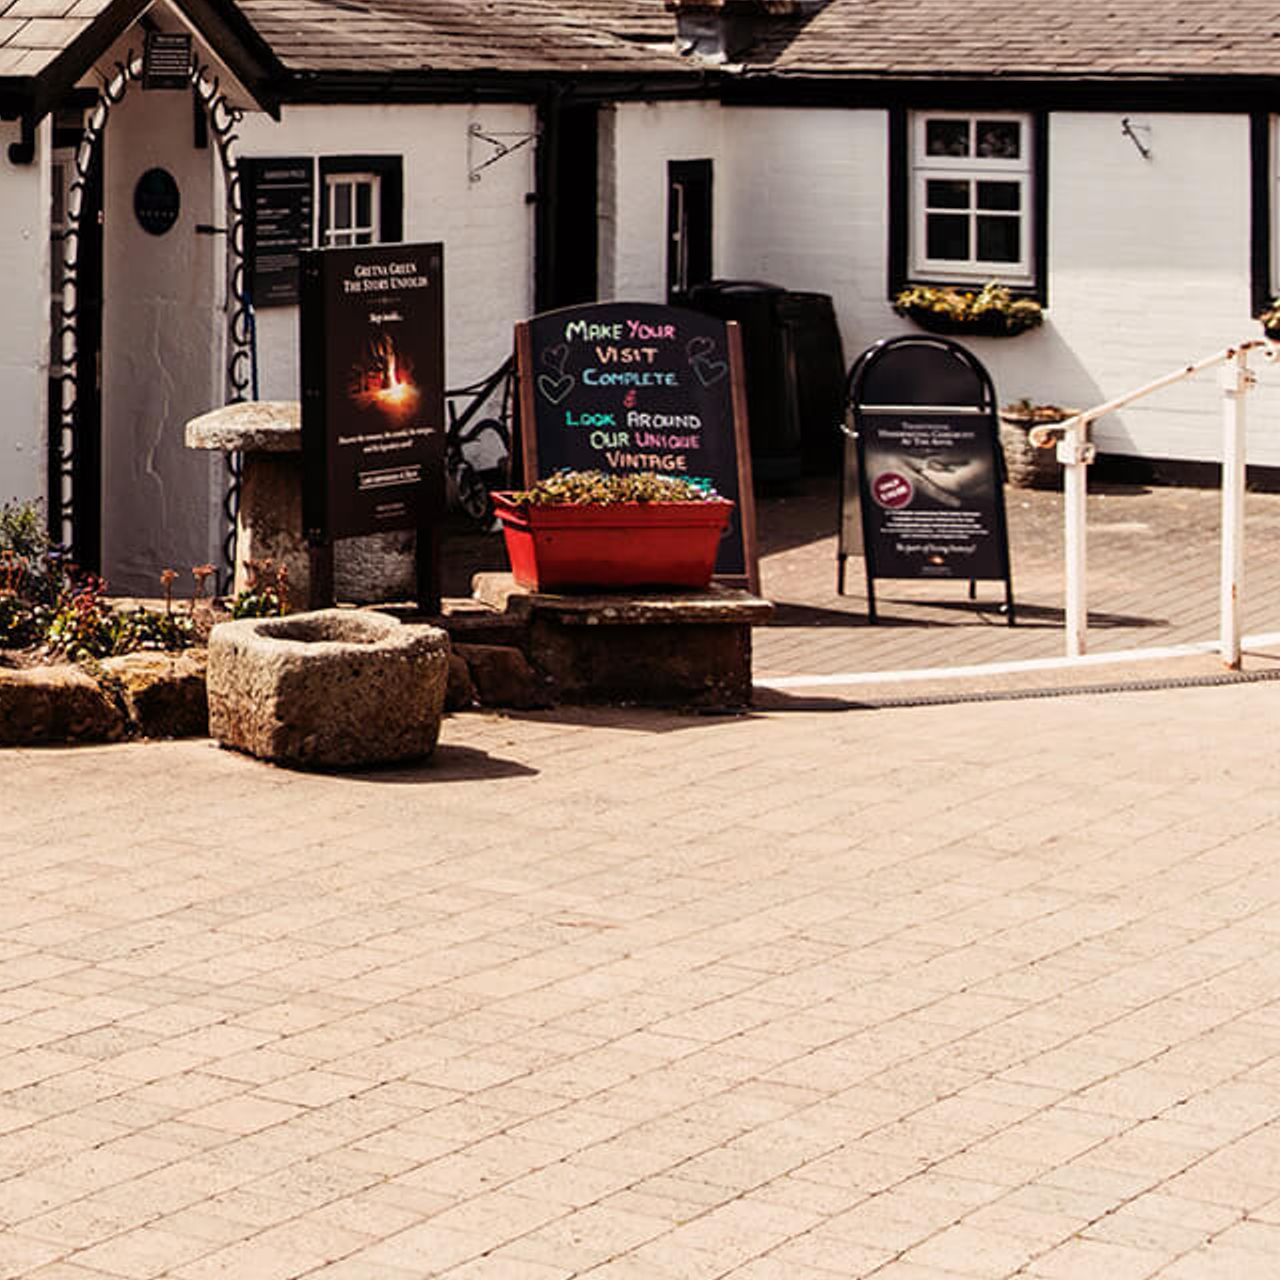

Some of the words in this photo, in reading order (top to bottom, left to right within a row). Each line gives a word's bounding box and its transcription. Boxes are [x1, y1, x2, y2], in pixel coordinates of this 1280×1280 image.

[343, 280, 361, 293] THE
[565, 320, 623, 342] MAKE
[626, 320, 676, 340] YOUR
[595, 346, 659, 365] VISIT
[582, 368, 679, 386] COMPLETE
[565, 411, 616, 427] LOOK
[627, 411, 702, 429] AROUND
[590, 431, 630, 449] OUR
[635, 432, 701, 449] UNIQUE
[606, 452, 688, 470] VINTAGE
